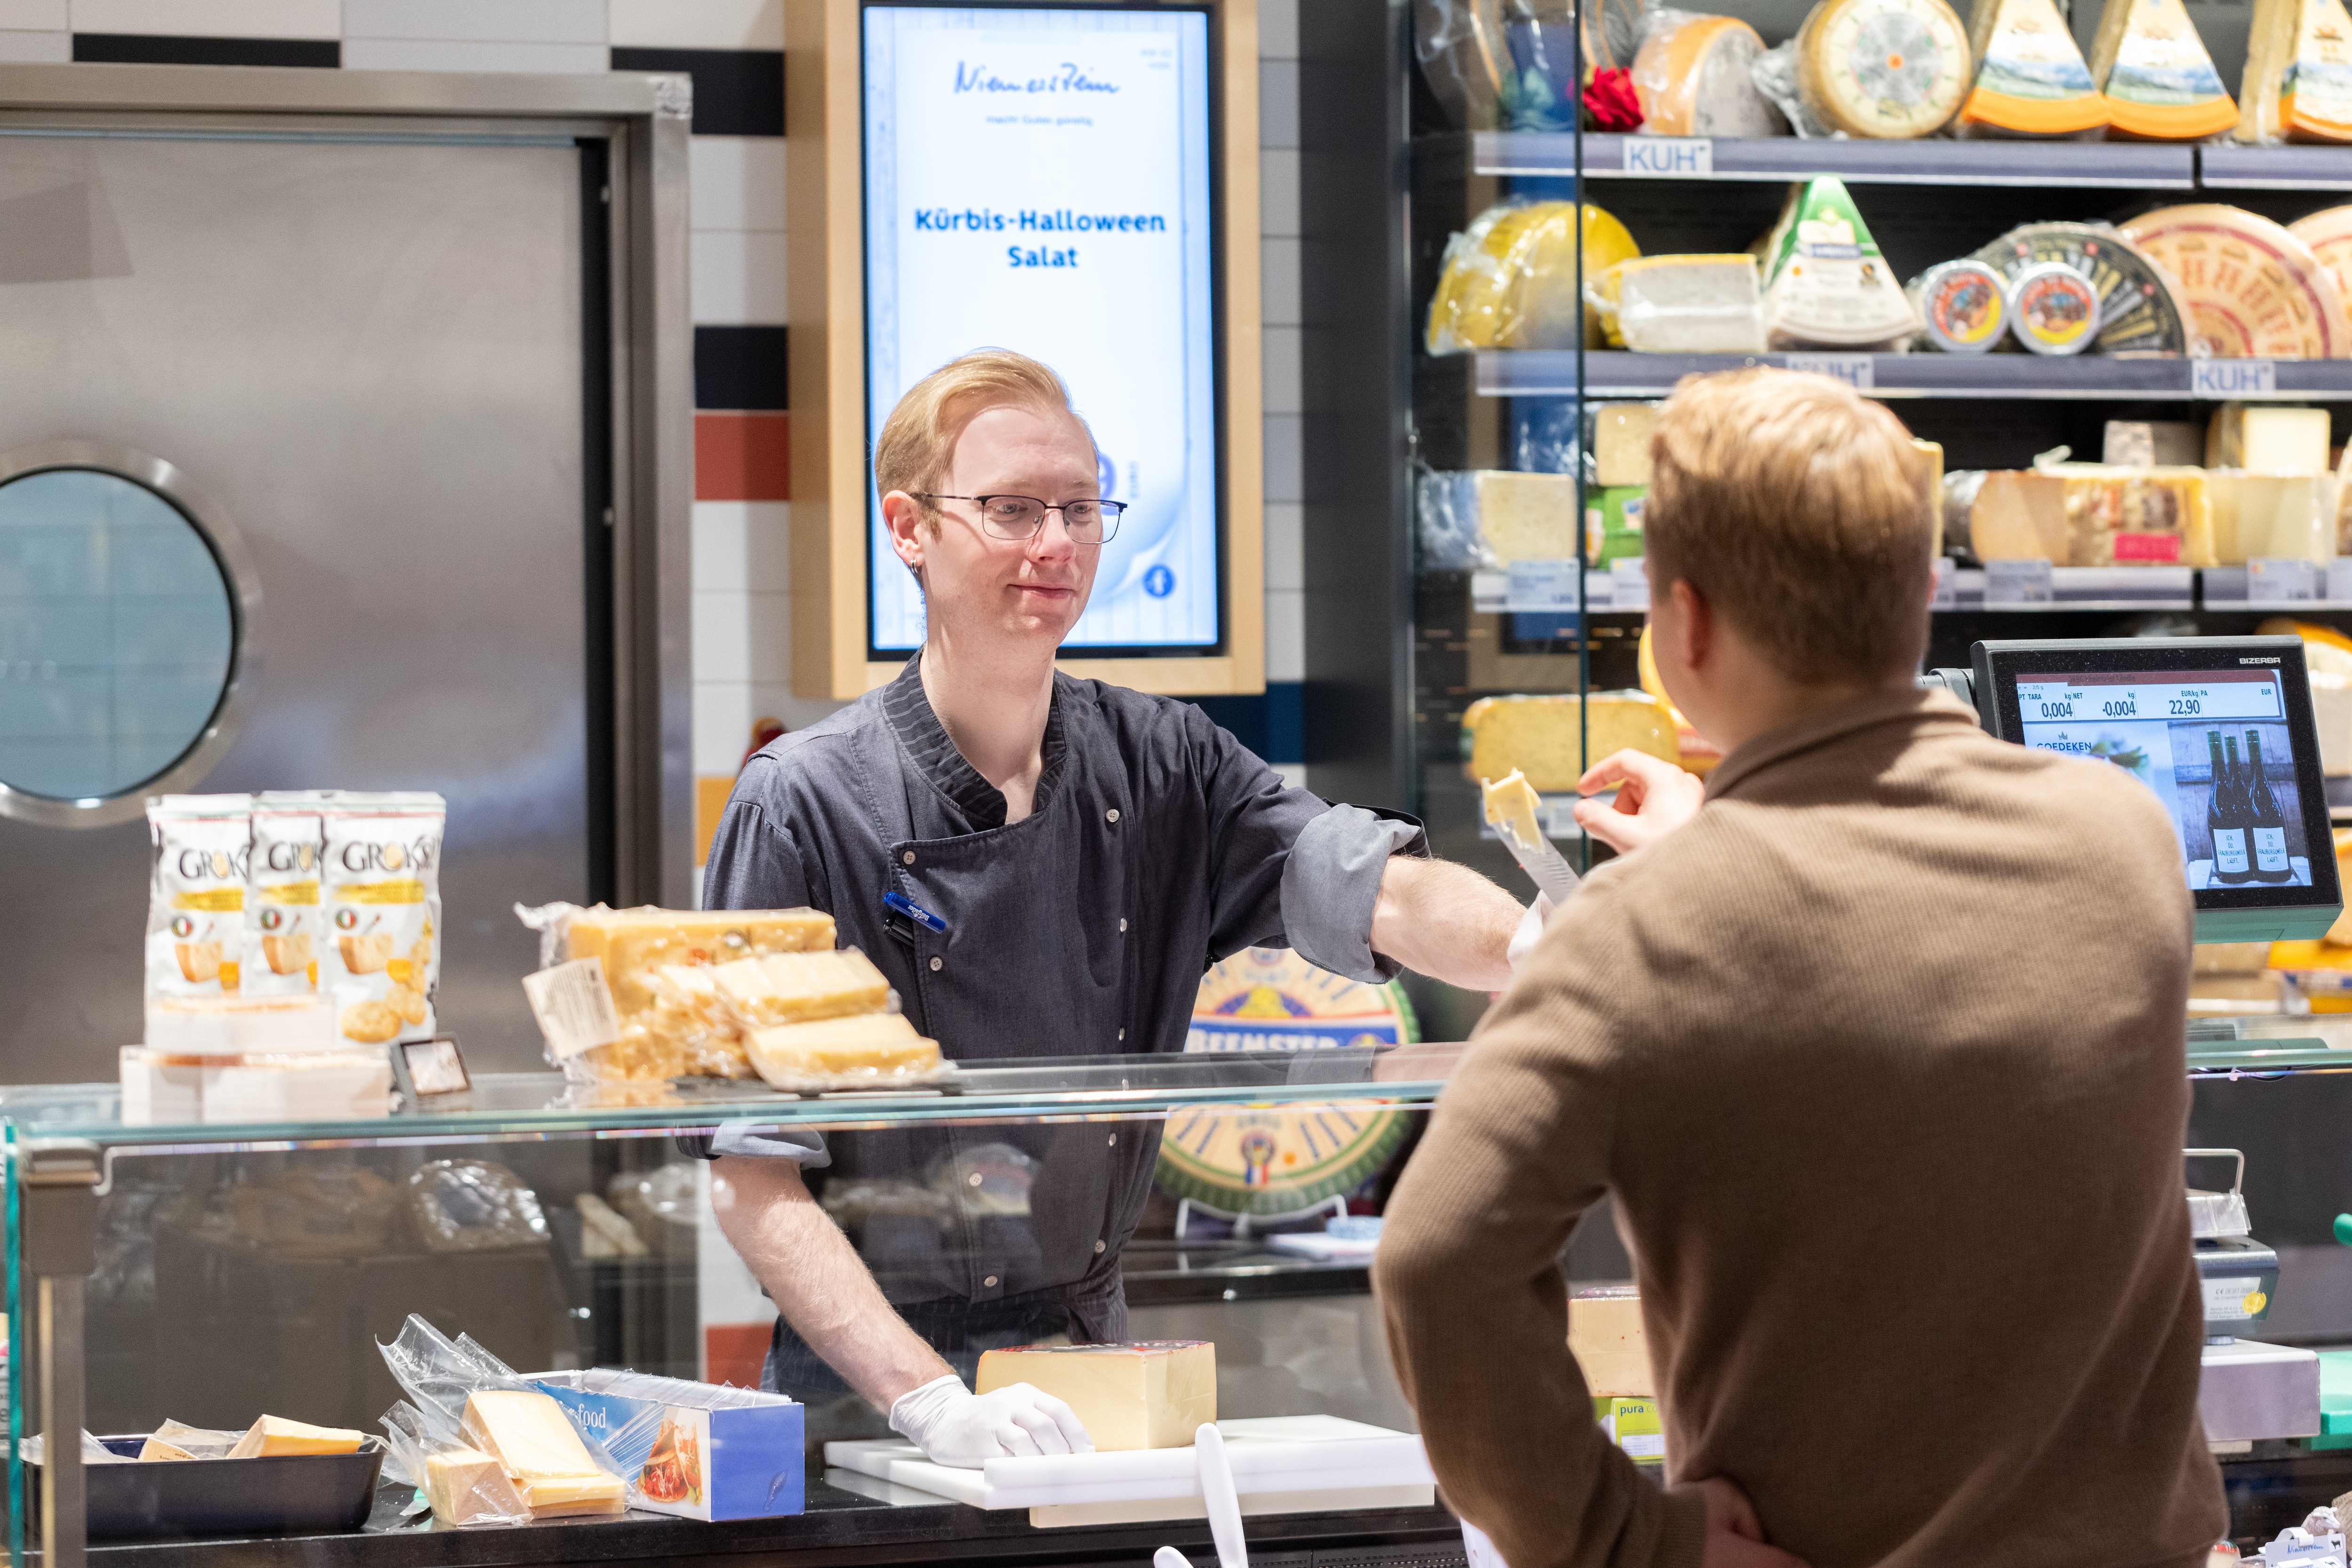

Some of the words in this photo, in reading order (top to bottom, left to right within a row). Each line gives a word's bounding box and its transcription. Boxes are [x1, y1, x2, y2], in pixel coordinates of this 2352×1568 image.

[914, 208, 1166, 232] Kürbis-Halloween
[1008, 245, 1079, 268] Salat
[2041, 702, 2073, 719] 0,004
[2103, 701, 2136, 717] -0,004
[2169, 699, 2201, 716] 22,90
[179, 845, 248, 879] GROK
[907, 904, 930, 921] Bergader
[578, 1403, 606, 1428] food
[1620, 1405, 1644, 1417] pura
